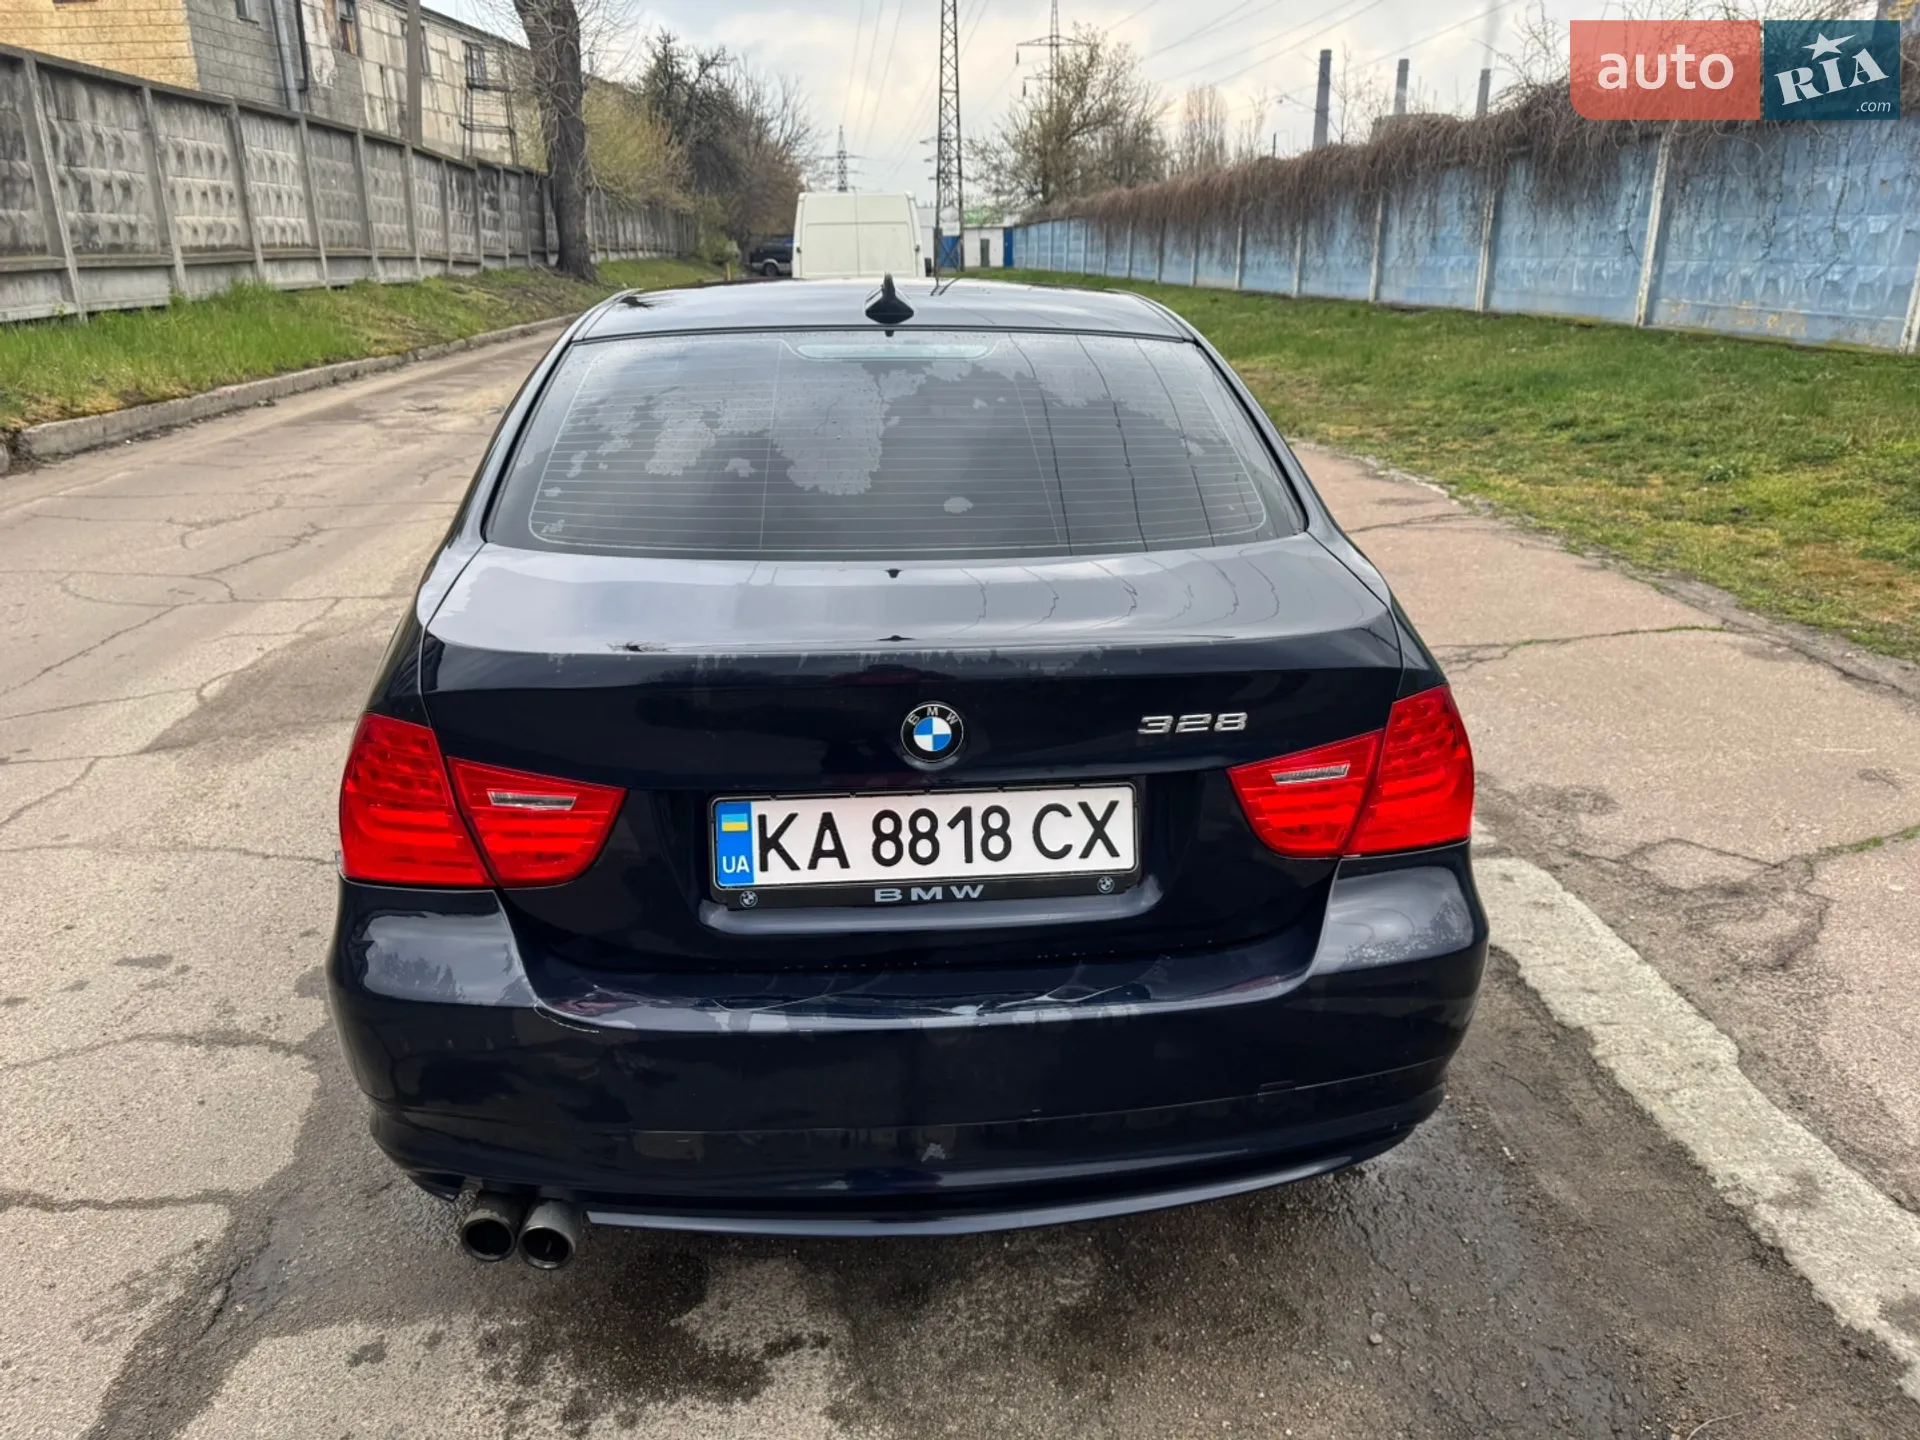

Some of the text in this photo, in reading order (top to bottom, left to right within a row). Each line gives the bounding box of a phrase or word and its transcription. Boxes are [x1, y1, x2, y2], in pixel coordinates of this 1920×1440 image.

[907, 706, 958, 726] BMW
[1137, 712, 1248, 734] 328
[757, 800, 1120, 873] KA 8818 CX
[722, 856, 750, 874] UA
[874, 884, 984, 903] BMW
